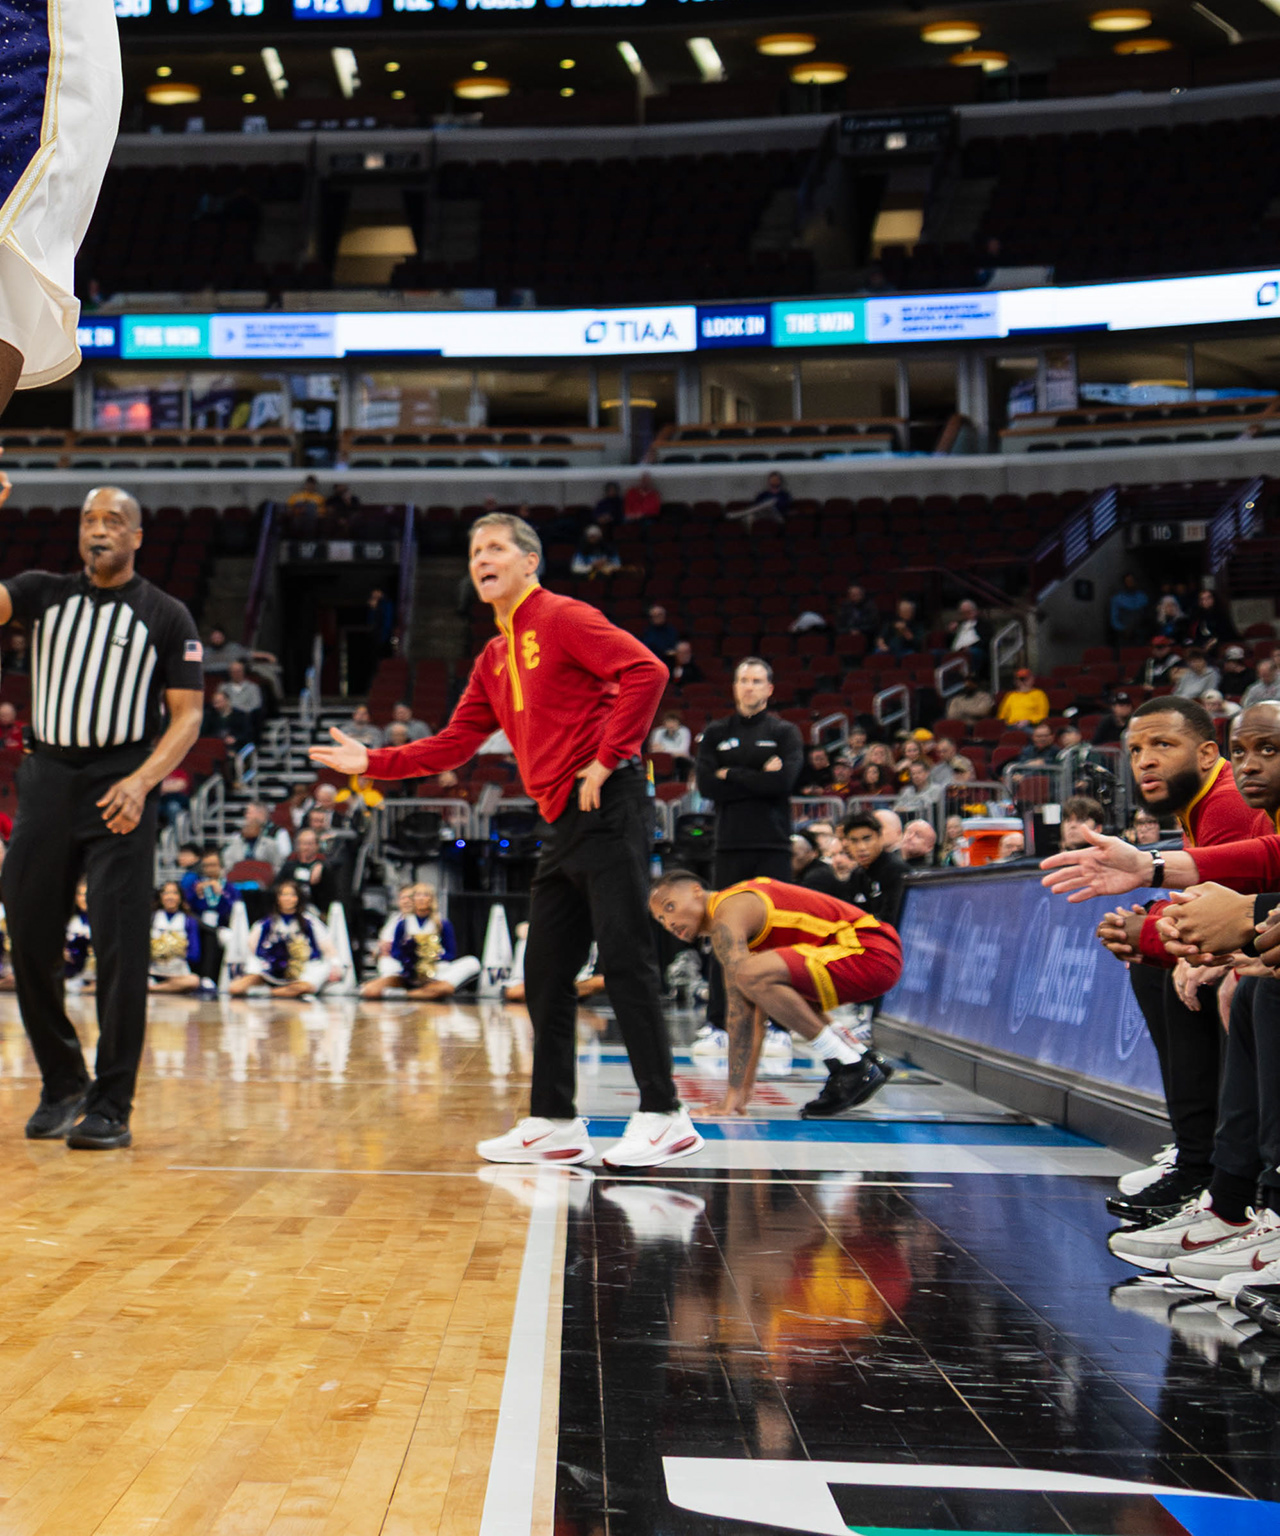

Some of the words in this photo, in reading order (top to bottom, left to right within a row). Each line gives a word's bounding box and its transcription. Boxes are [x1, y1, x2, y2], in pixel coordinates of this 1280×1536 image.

[614, 320, 681, 343] TIAA
[700, 315, 746, 339] LOCK
[782, 312, 818, 335] THE
[816, 310, 856, 333] WIN
[520, 629, 542, 671] SC
